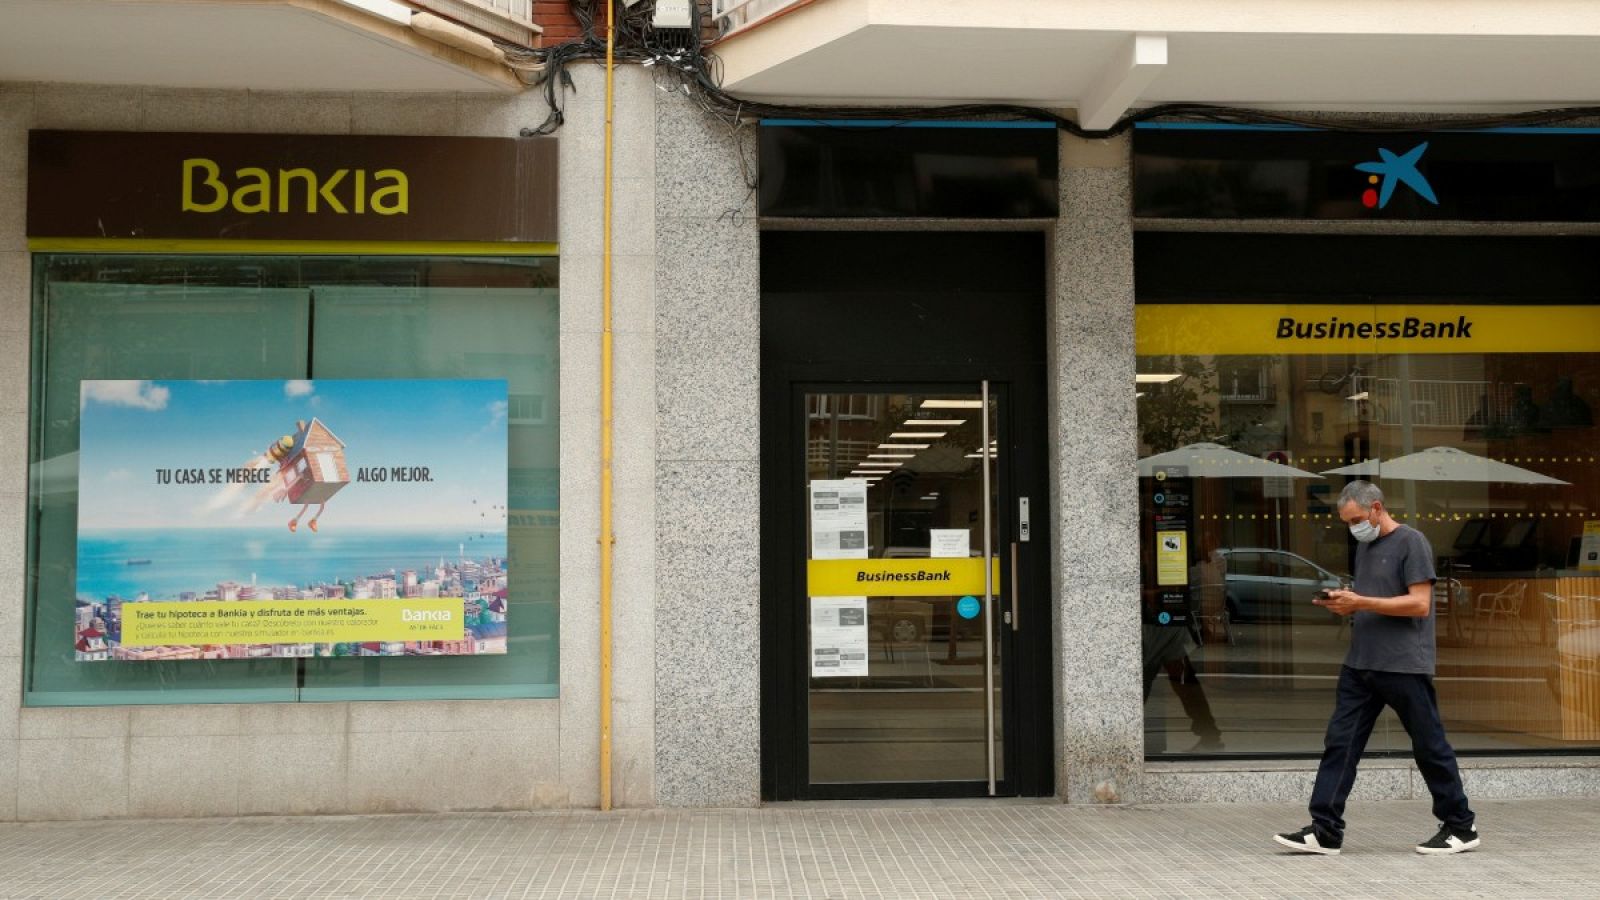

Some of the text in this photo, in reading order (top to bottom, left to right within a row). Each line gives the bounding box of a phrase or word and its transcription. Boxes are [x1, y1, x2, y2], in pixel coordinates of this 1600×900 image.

[181, 158, 409, 215] Bankia
[1276, 315, 1473, 340] BusinessBank
[155, 467, 434, 484] TU CASA SE MERECE ALGO MEJOR.
[856, 570, 951, 583] BusinessBank
[136, 610, 155, 619] Trae
[156, 610, 167, 618] tu
[168, 609, 208, 620] hipoteca
[218, 609, 248, 618] Bankia
[250, 610, 256, 618] y
[257, 608, 292, 617] disfruta
[294, 608, 305, 617] de
[307, 607, 326, 617] más
[327, 606, 368, 617] ventajas.
[402, 609, 450, 621] Bankia
